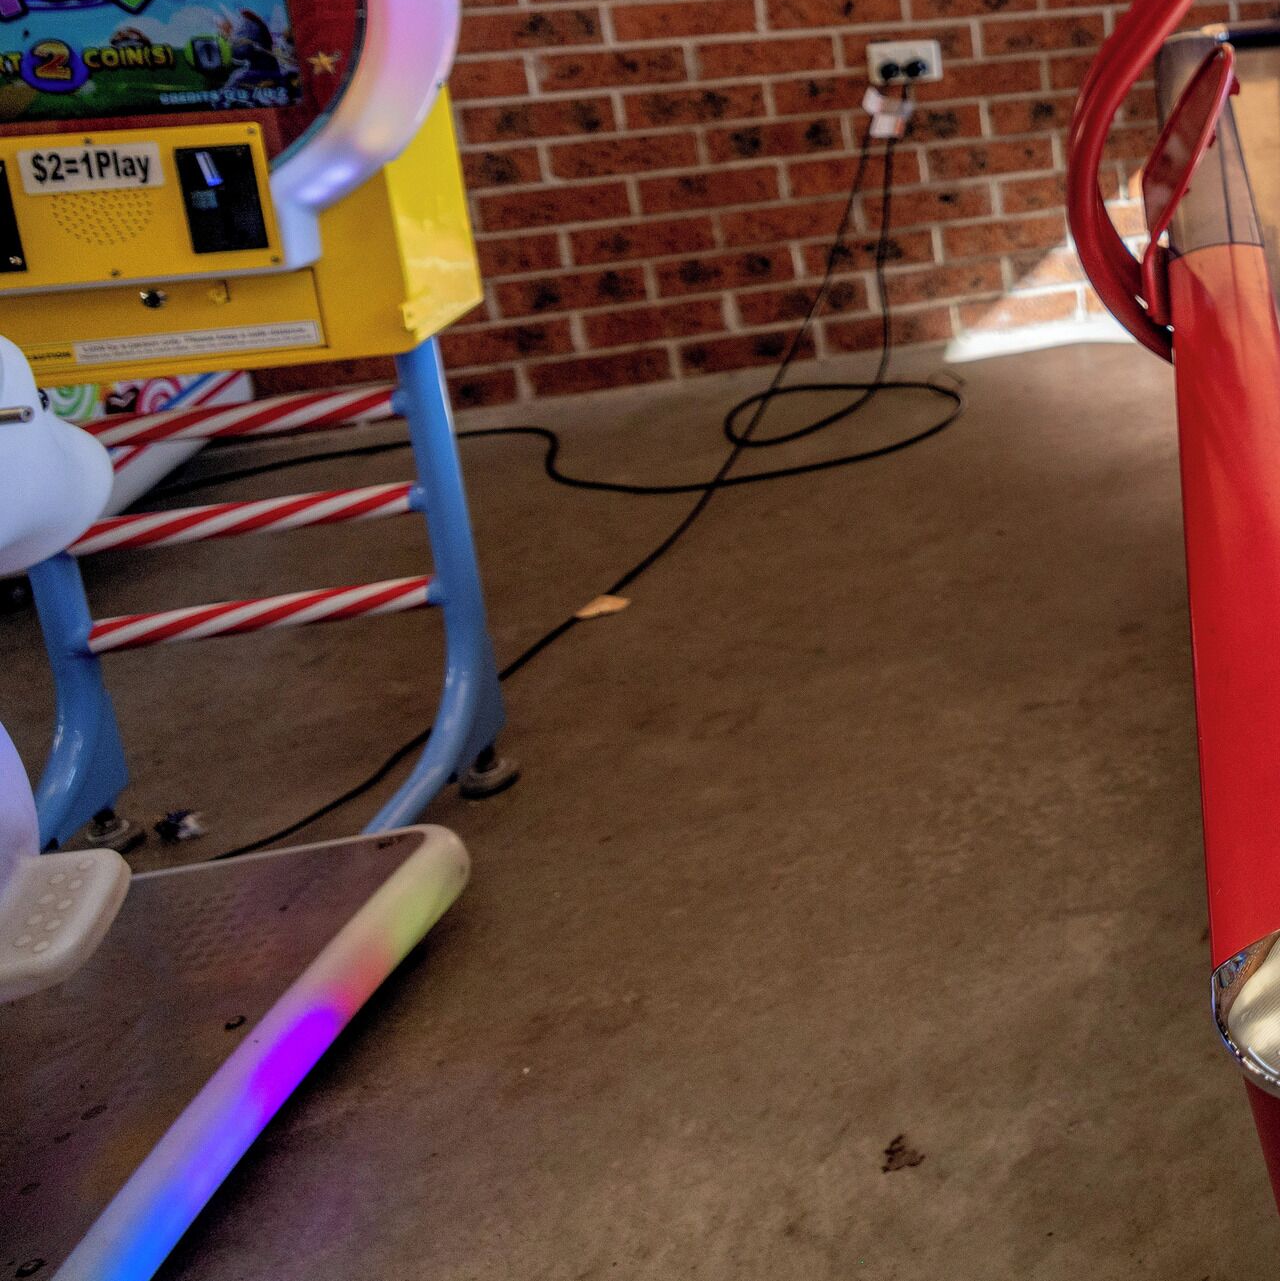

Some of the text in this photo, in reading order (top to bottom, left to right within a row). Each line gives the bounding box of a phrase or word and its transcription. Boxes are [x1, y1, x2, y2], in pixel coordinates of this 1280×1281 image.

[31, 41, 72, 81] 2
[82, 45, 174, 68] COIN(S)
[32, 149, 150, 185] $2=1Play
